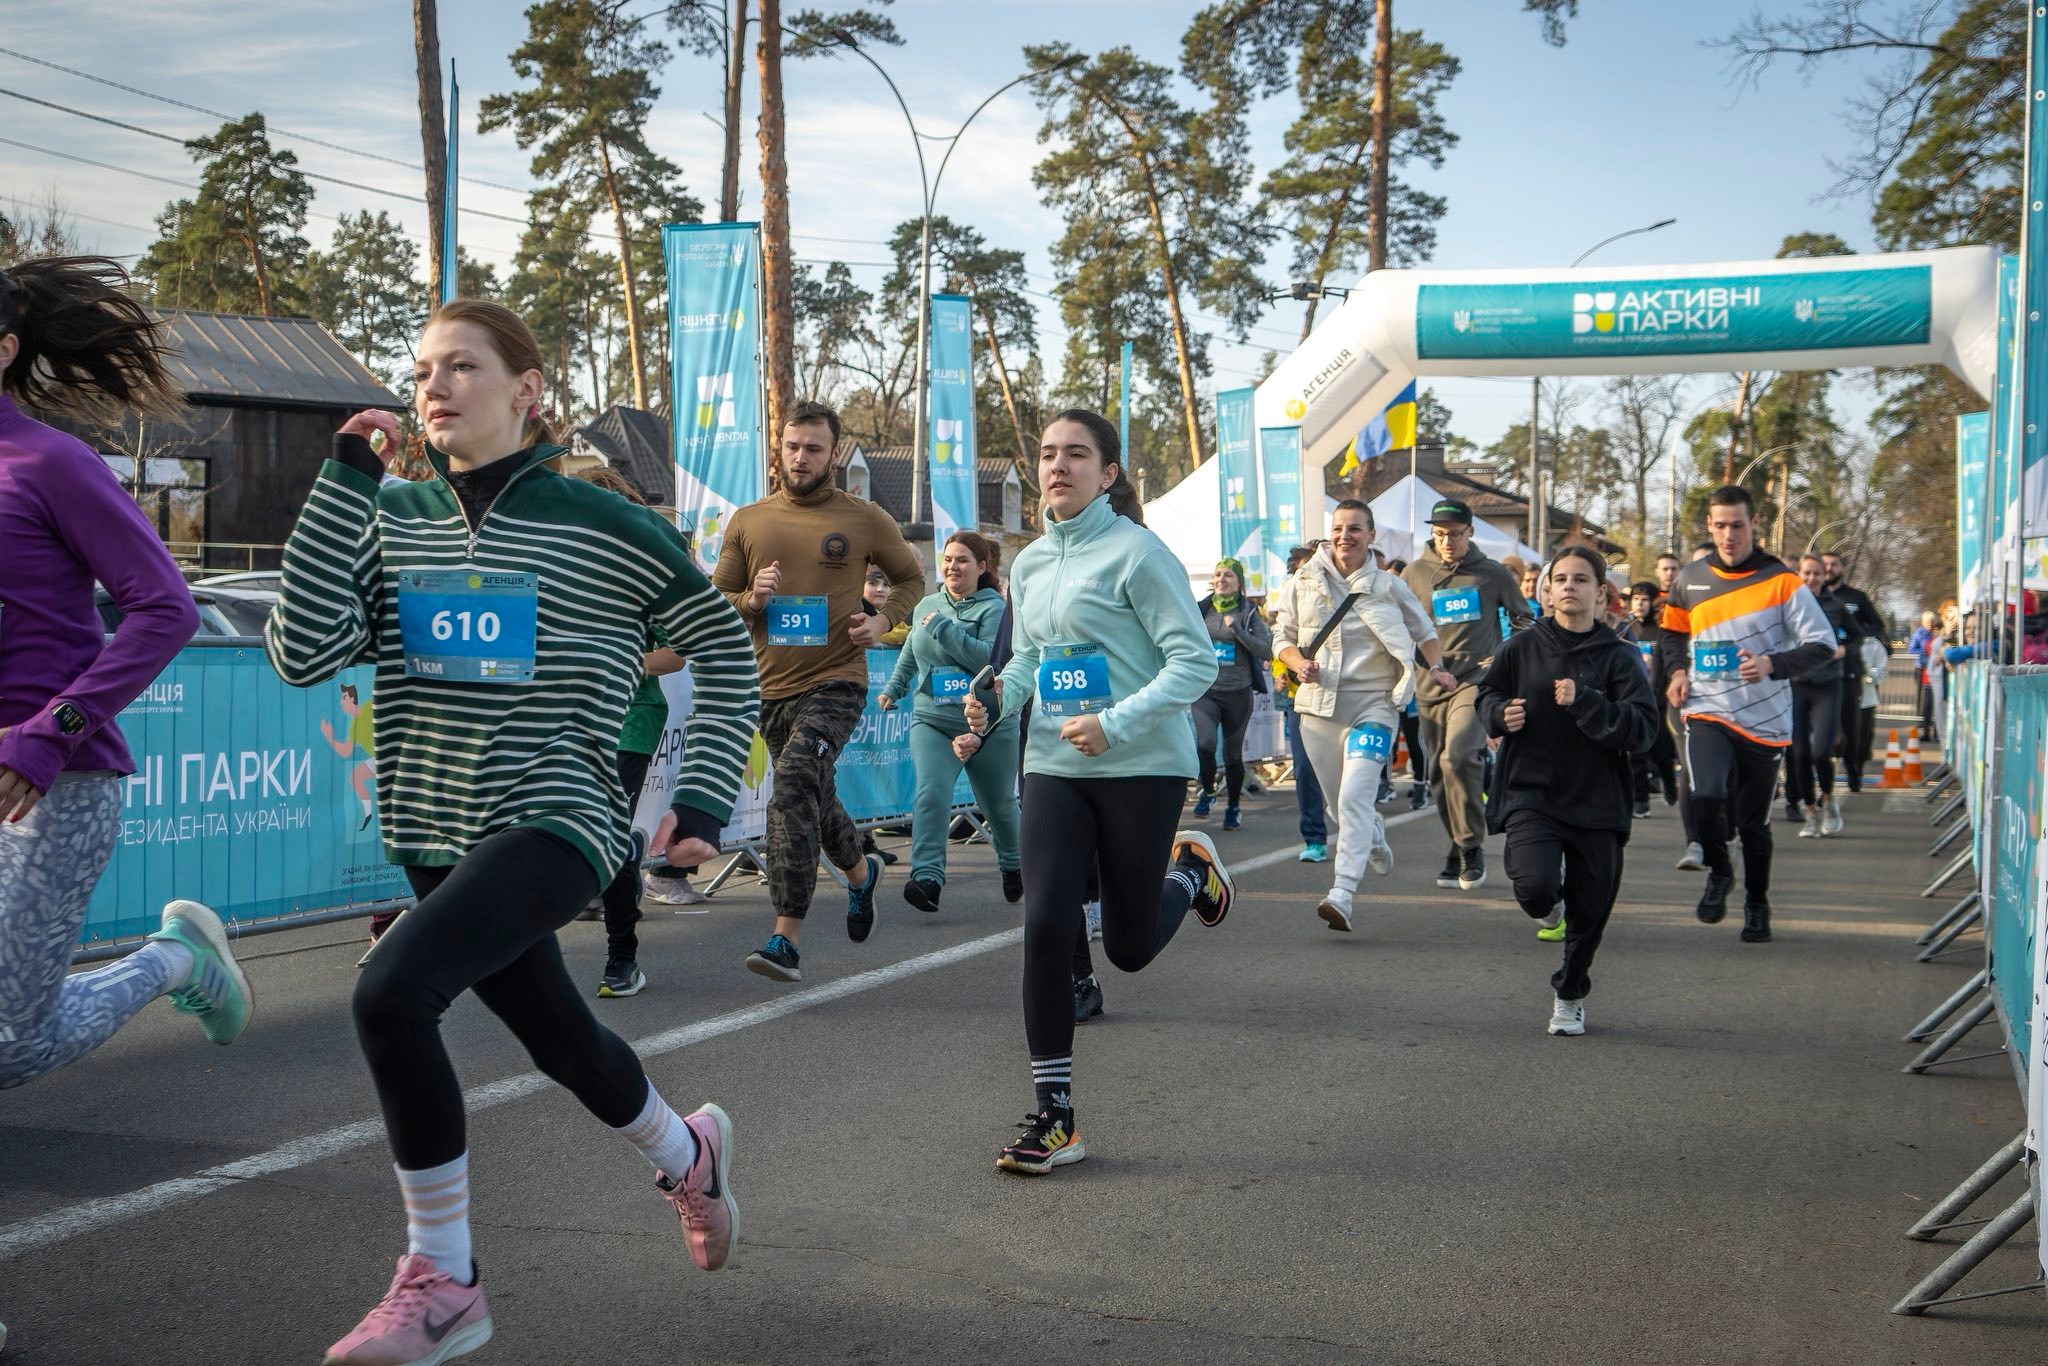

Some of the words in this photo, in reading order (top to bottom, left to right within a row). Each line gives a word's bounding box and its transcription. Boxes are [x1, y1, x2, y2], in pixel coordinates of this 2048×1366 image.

[1620, 286, 1761, 312] АКТИВНІ
[1618, 308, 1729, 333] ПАРКИ
[1302, 348, 1352, 400] АГЕНЦІЯ
[482, 576, 525, 585] АГЕНЦІЯ
[1445, 599, 1469, 611] 580
[431, 610, 501, 642] 610
[781, 614, 810, 628] 591
[1703, 654, 1728, 667] 615
[944, 679, 968, 691] 596
[1052, 670, 1088, 691] 598
[134, 684, 183, 704] НЦІЯ
[649, 728, 687, 767] АРК
[1359, 734, 1384, 748] 612
[119, 755, 163, 808] НІ
[180, 749, 311, 804] ПАРКИ
[234, 803, 311, 836] УКРАЇНИ
